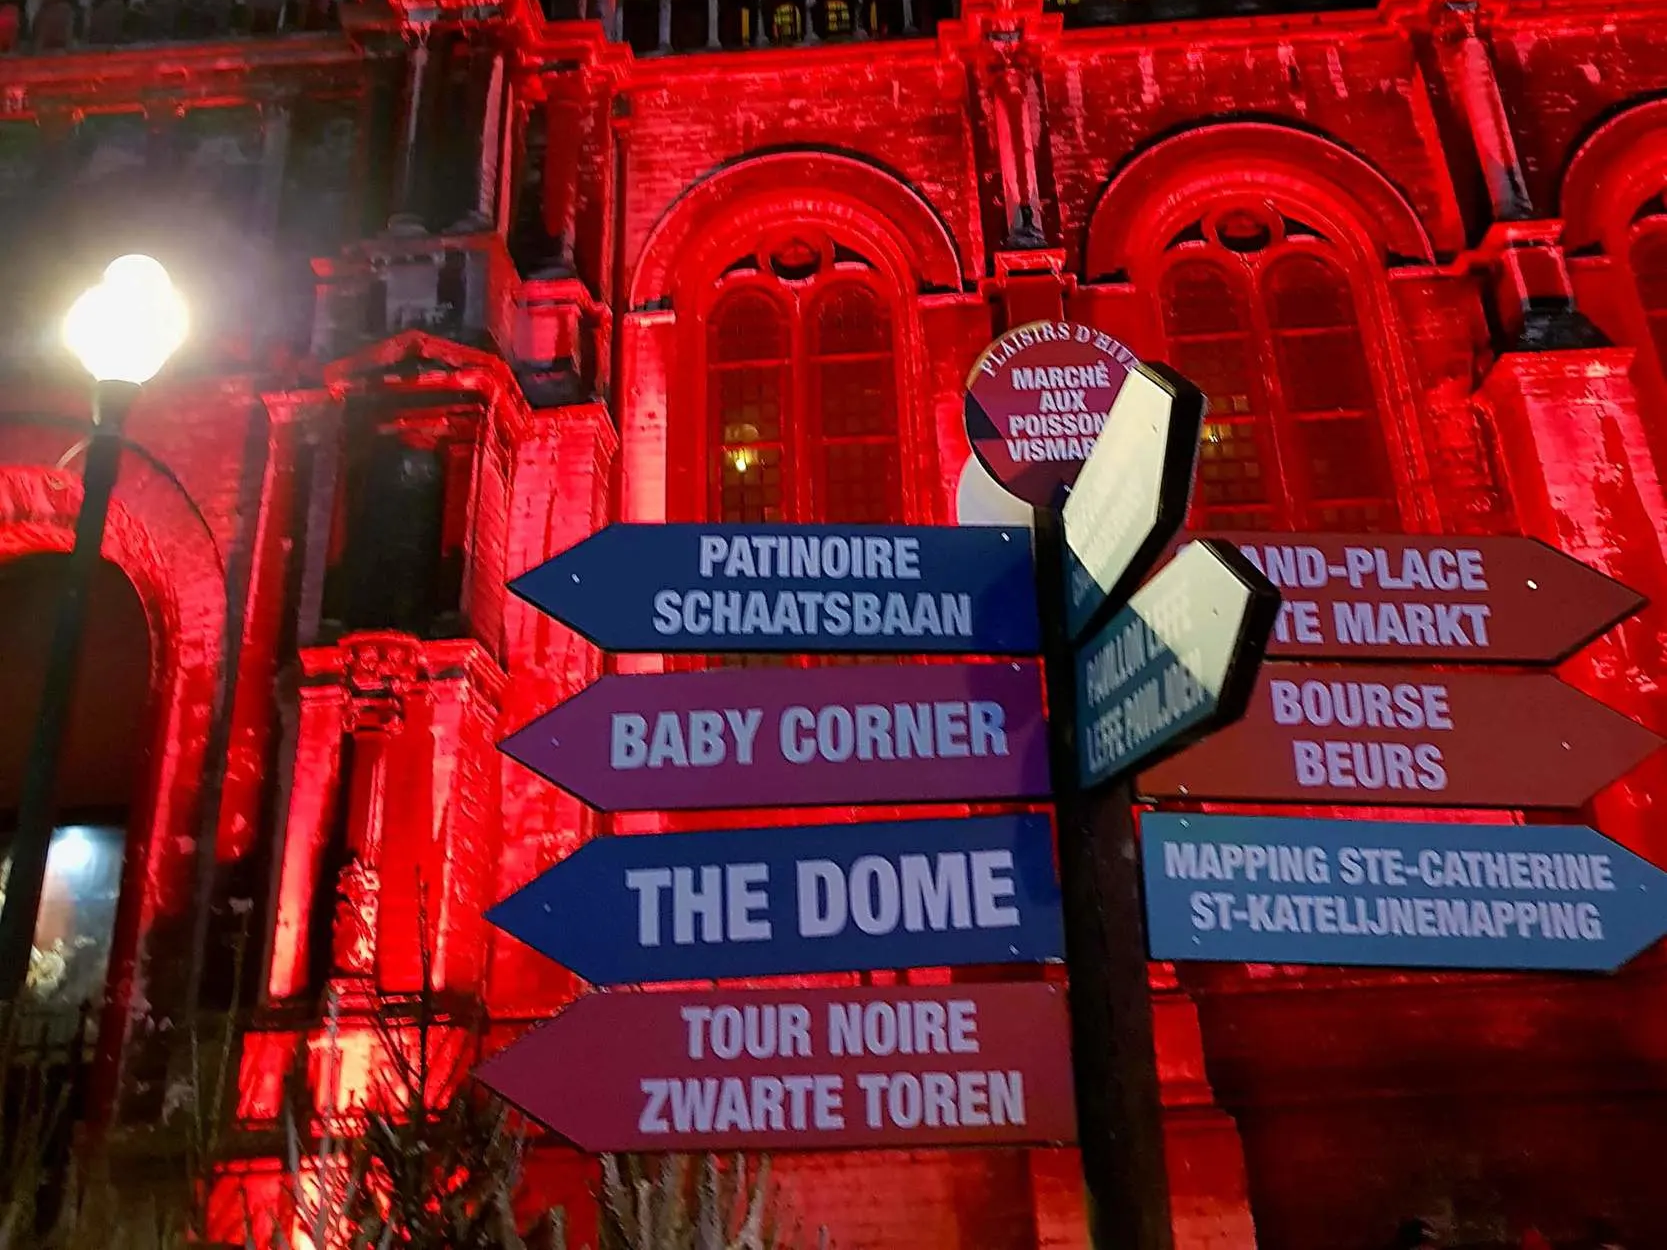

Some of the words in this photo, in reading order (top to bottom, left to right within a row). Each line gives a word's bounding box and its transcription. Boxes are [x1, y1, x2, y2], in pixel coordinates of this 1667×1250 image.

[1074, 324, 1140, 373] D'HIVE
[1011, 360, 1111, 390] MARCHÉ
[1008, 411, 1110, 437] POISSON
[1039, 390, 1088, 412] AUX
[1005, 436, 1098, 462] VISMAR
[699, 535, 920, 578] PATINOIRE
[1239, 545, 1488, 592] ND-PLACE
[653, 591, 973, 636] SCHAATSBAAN
[1333, 602, 1491, 646] MARKT
[1270, 679, 1453, 730] BOURSE
[610, 708, 763, 770] BABY
[780, 701, 1009, 764] CORNER
[1292, 740, 1447, 790] BEURS
[1163, 841, 1330, 885] MAPPING
[1338, 847, 1616, 892] STE-CATHERINE
[625, 862, 772, 947] THE
[796, 849, 1021, 938] DOME
[1189, 893, 1604, 941] ST-KATELIJNEMAPPING
[681, 1005, 812, 1060] TOUR
[828, 1000, 981, 1054] NOIRE
[638, 1075, 845, 1134] ZWARTE
[857, 1070, 1027, 1126] TOREN
